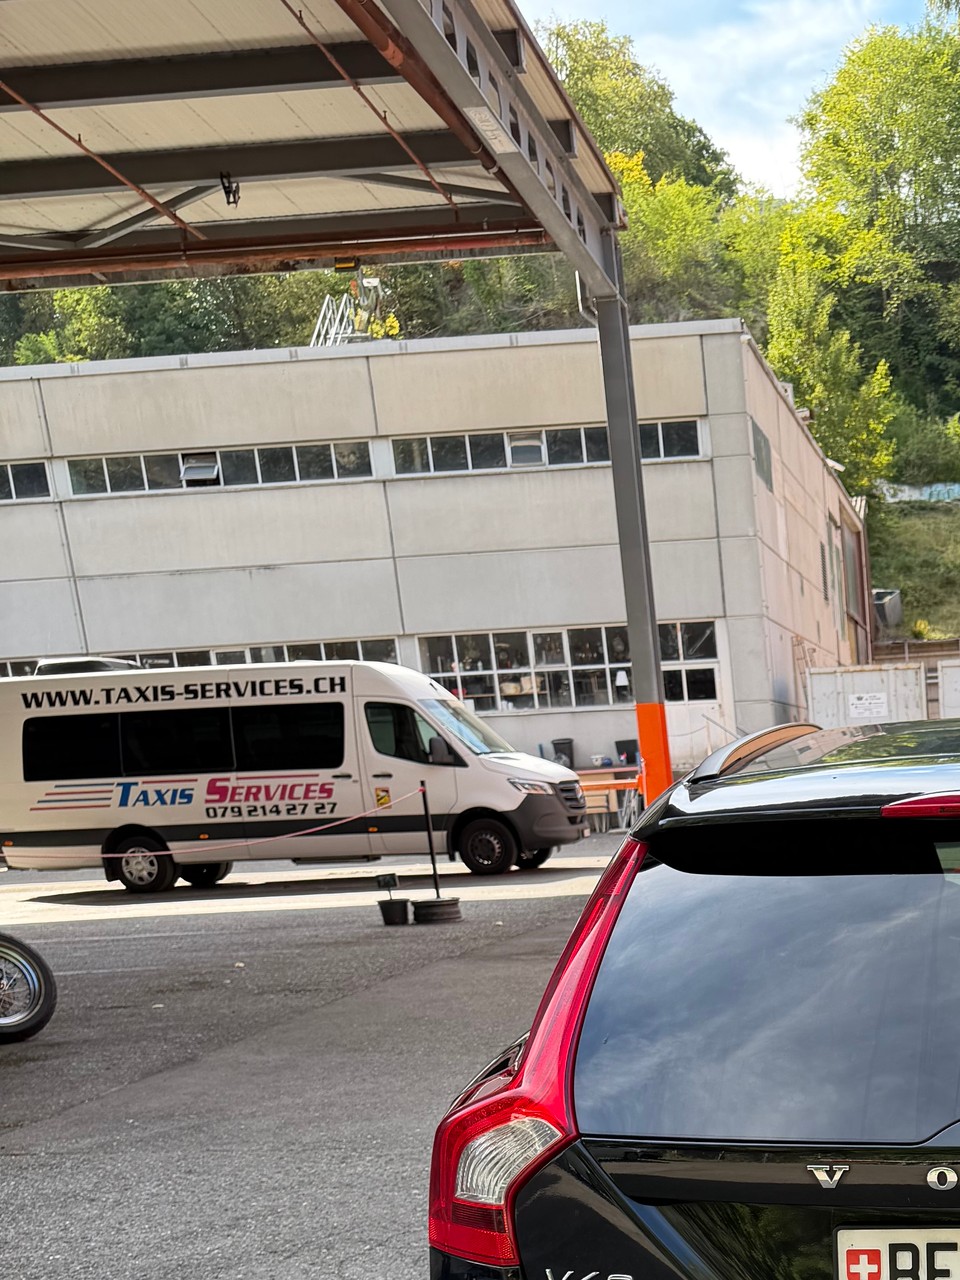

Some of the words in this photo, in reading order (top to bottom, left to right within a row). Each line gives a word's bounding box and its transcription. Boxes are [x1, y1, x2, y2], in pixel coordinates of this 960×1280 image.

[21, 676, 347, 709] WWW.TAXIS-SERVICES.CH
[205, 806, 243, 818] 079
[246, 804, 282, 817] 214
[285, 803, 309, 815] 27
[314, 802, 337, 814] 27
